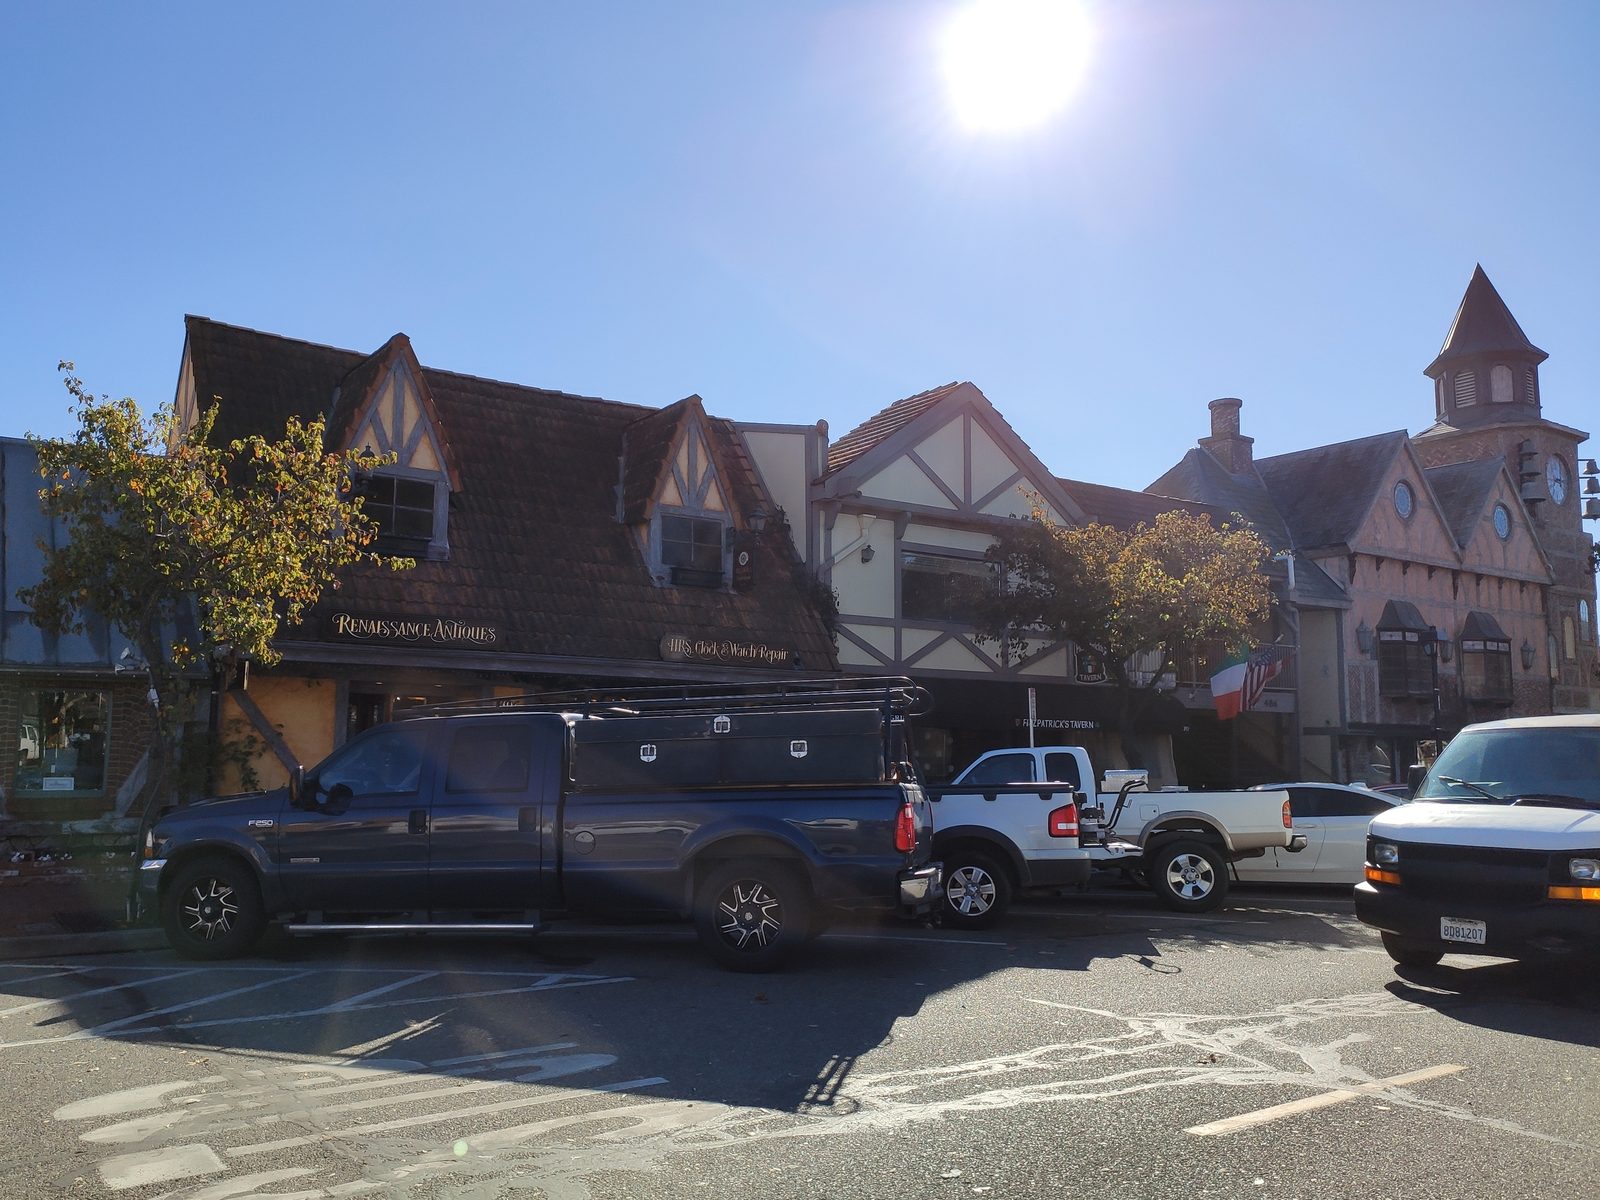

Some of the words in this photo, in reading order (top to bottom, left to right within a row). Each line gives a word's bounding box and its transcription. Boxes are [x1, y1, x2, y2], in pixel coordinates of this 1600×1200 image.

[695, 640, 723, 660] Clock
[729, 640, 758, 661] Watch
[758, 644, 789, 664] Repair
[1079, 673, 1102, 681] TAVERN
[1023, 718, 1069, 729] FIZPATRICK'S
[1070, 720, 1094, 729] TAVERN
[1443, 925, 1483, 940] 8D81207
